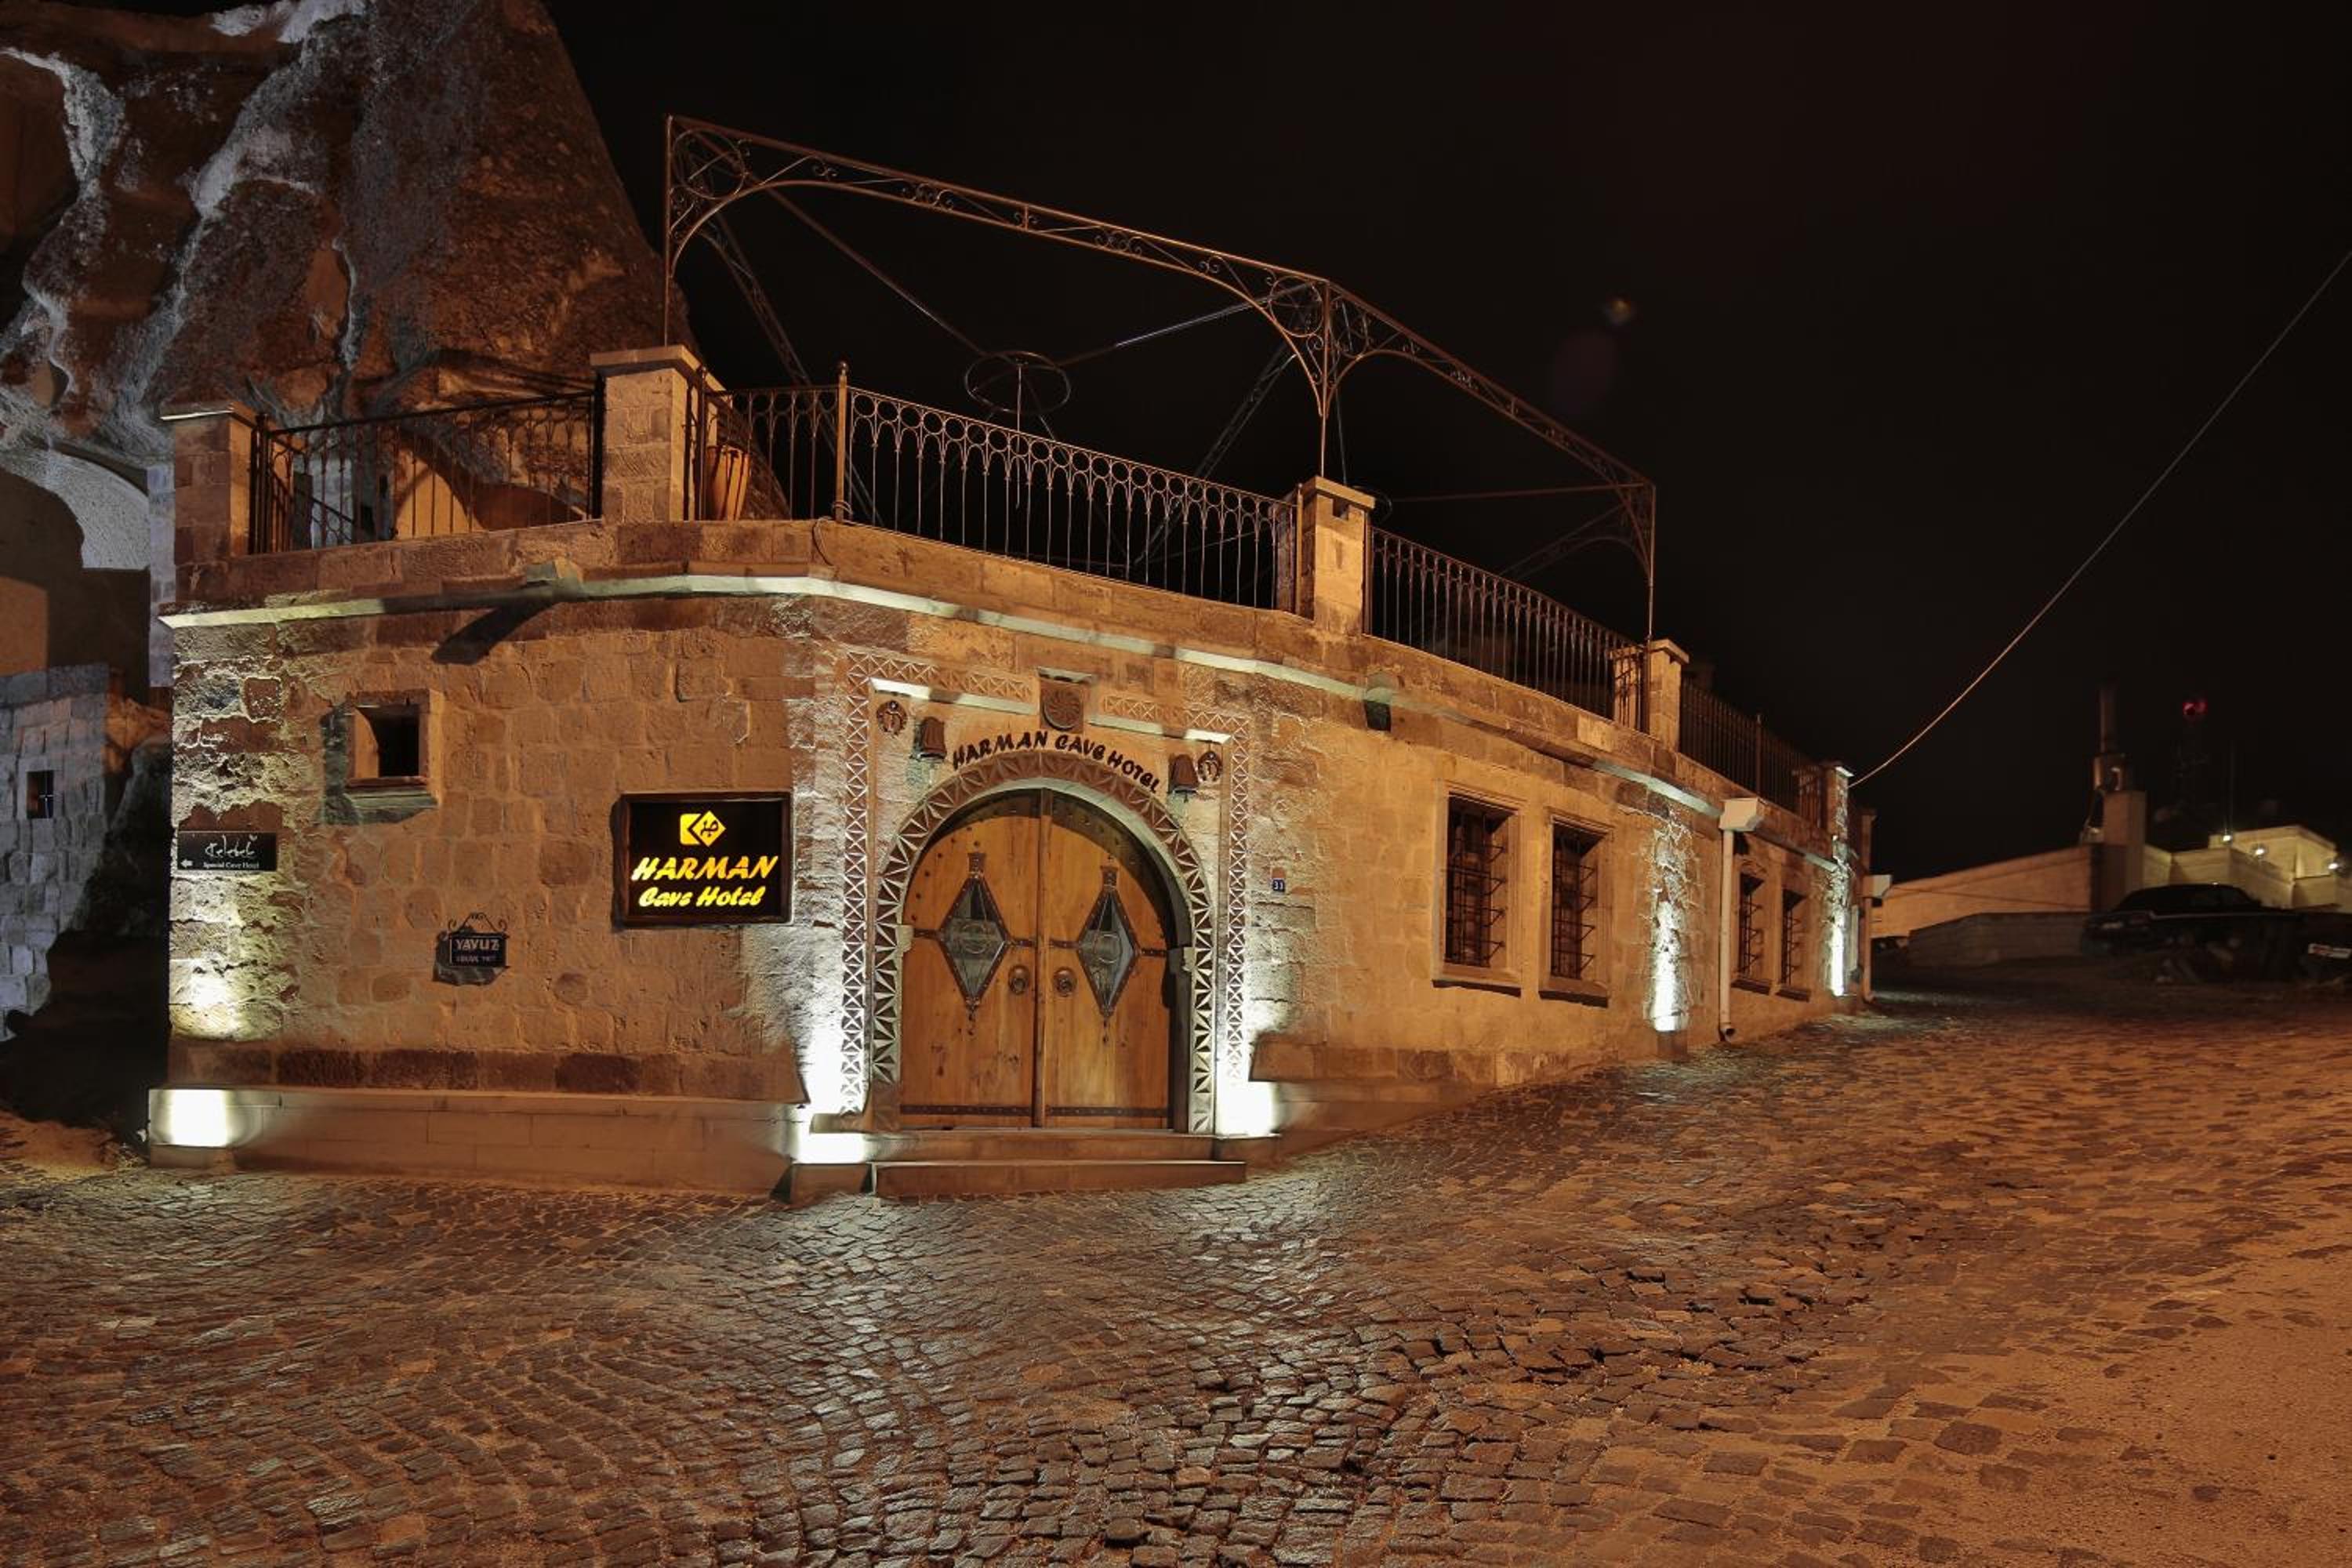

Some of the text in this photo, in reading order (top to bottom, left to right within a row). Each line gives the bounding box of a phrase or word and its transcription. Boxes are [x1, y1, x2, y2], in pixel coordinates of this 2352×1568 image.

[953, 731, 1048, 770] HARMAN
[630, 855, 779, 881] HARMAN
[638, 886, 766, 907] Cave Hotel
[456, 938, 499, 951] YAVUZ
